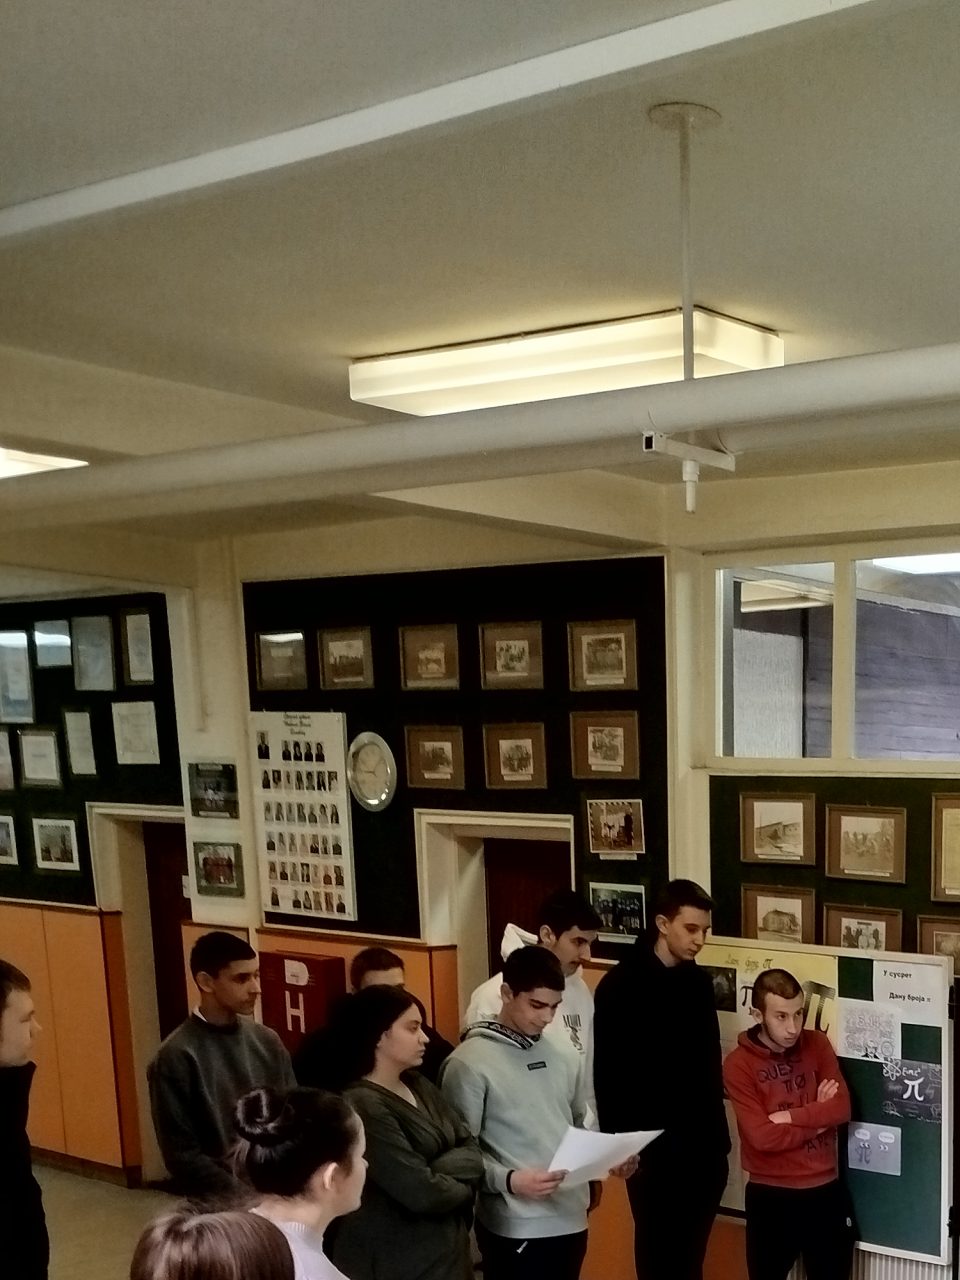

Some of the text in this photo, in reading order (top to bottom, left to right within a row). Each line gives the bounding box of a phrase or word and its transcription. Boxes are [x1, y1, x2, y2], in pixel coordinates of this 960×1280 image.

[889, 971, 912, 979] сусрет
[889, 992, 906, 1001] Дану
[907, 994, 925, 1003] броја
[284, 990, 306, 1034] H
